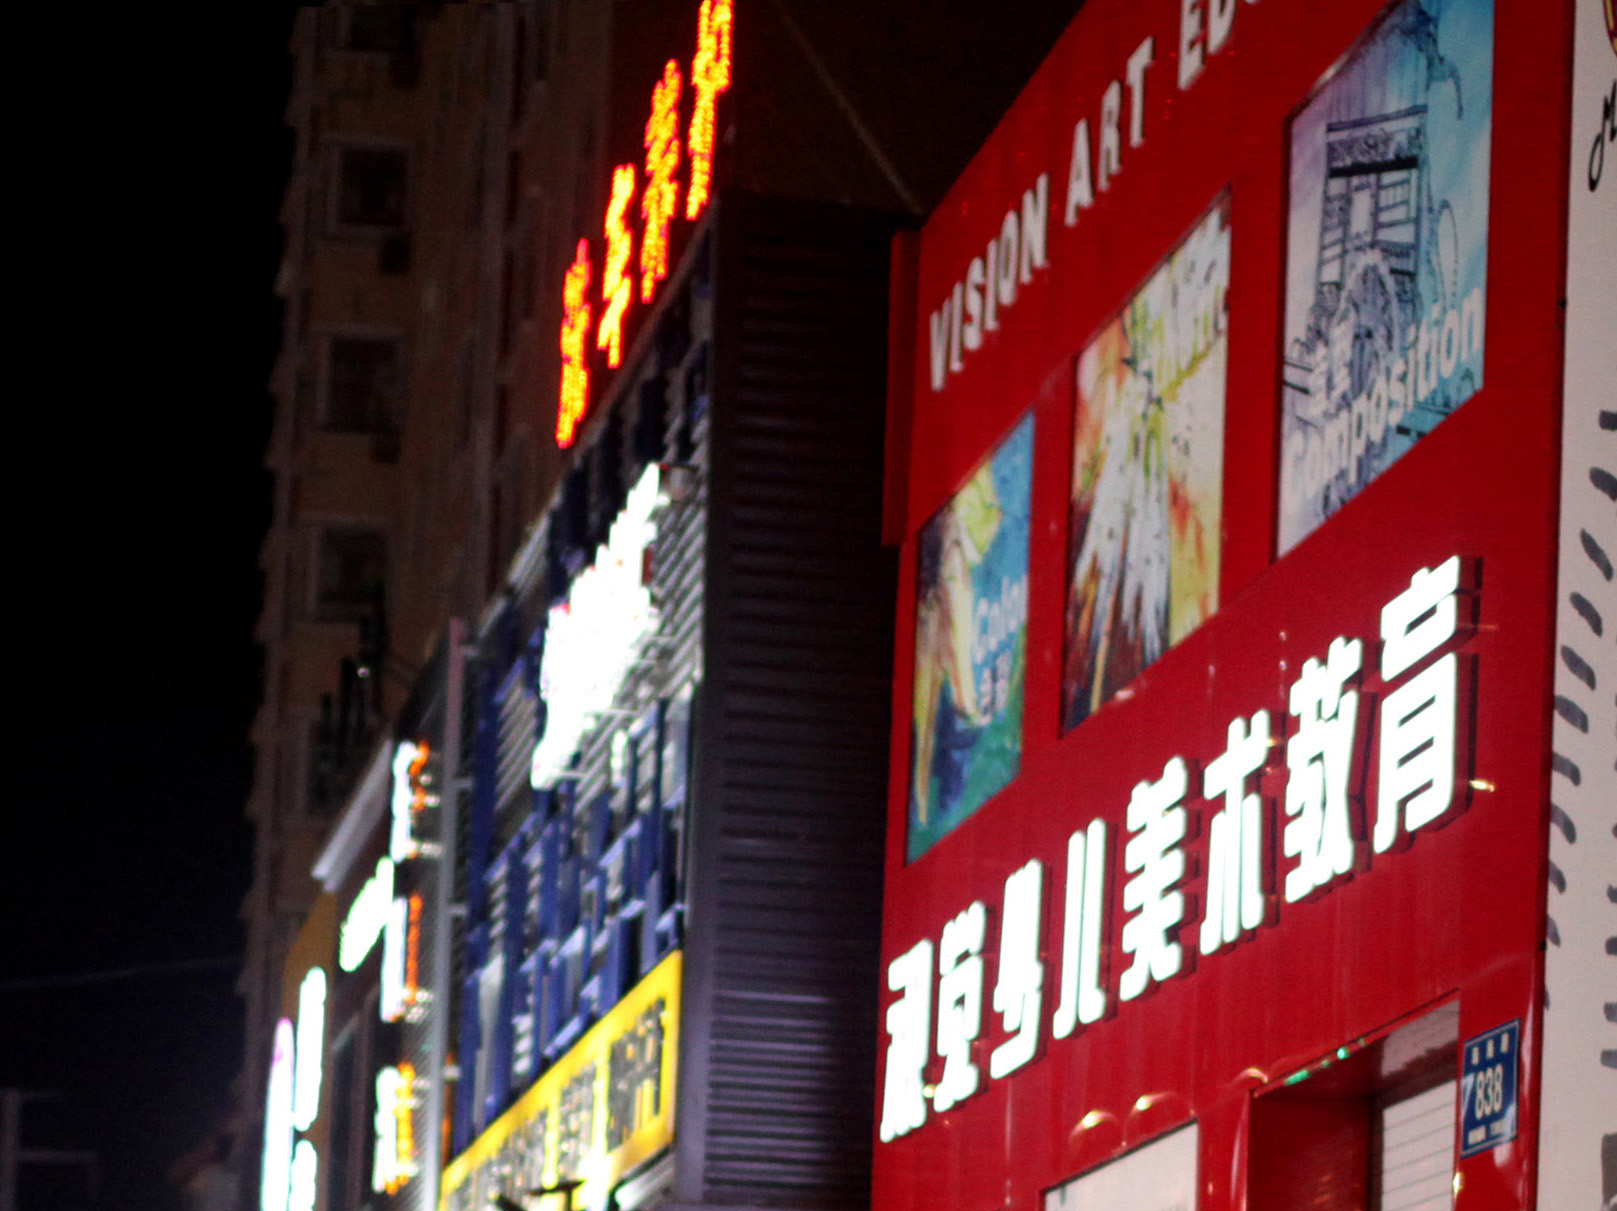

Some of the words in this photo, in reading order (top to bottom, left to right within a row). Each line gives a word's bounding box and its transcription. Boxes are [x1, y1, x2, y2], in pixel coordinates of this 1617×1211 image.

[929, 171, 1049, 392] VISION
[1063, 34, 1154, 228] ART
[1281, 287, 1483, 503] Composition
[1474, 1063, 1503, 1120] 838
